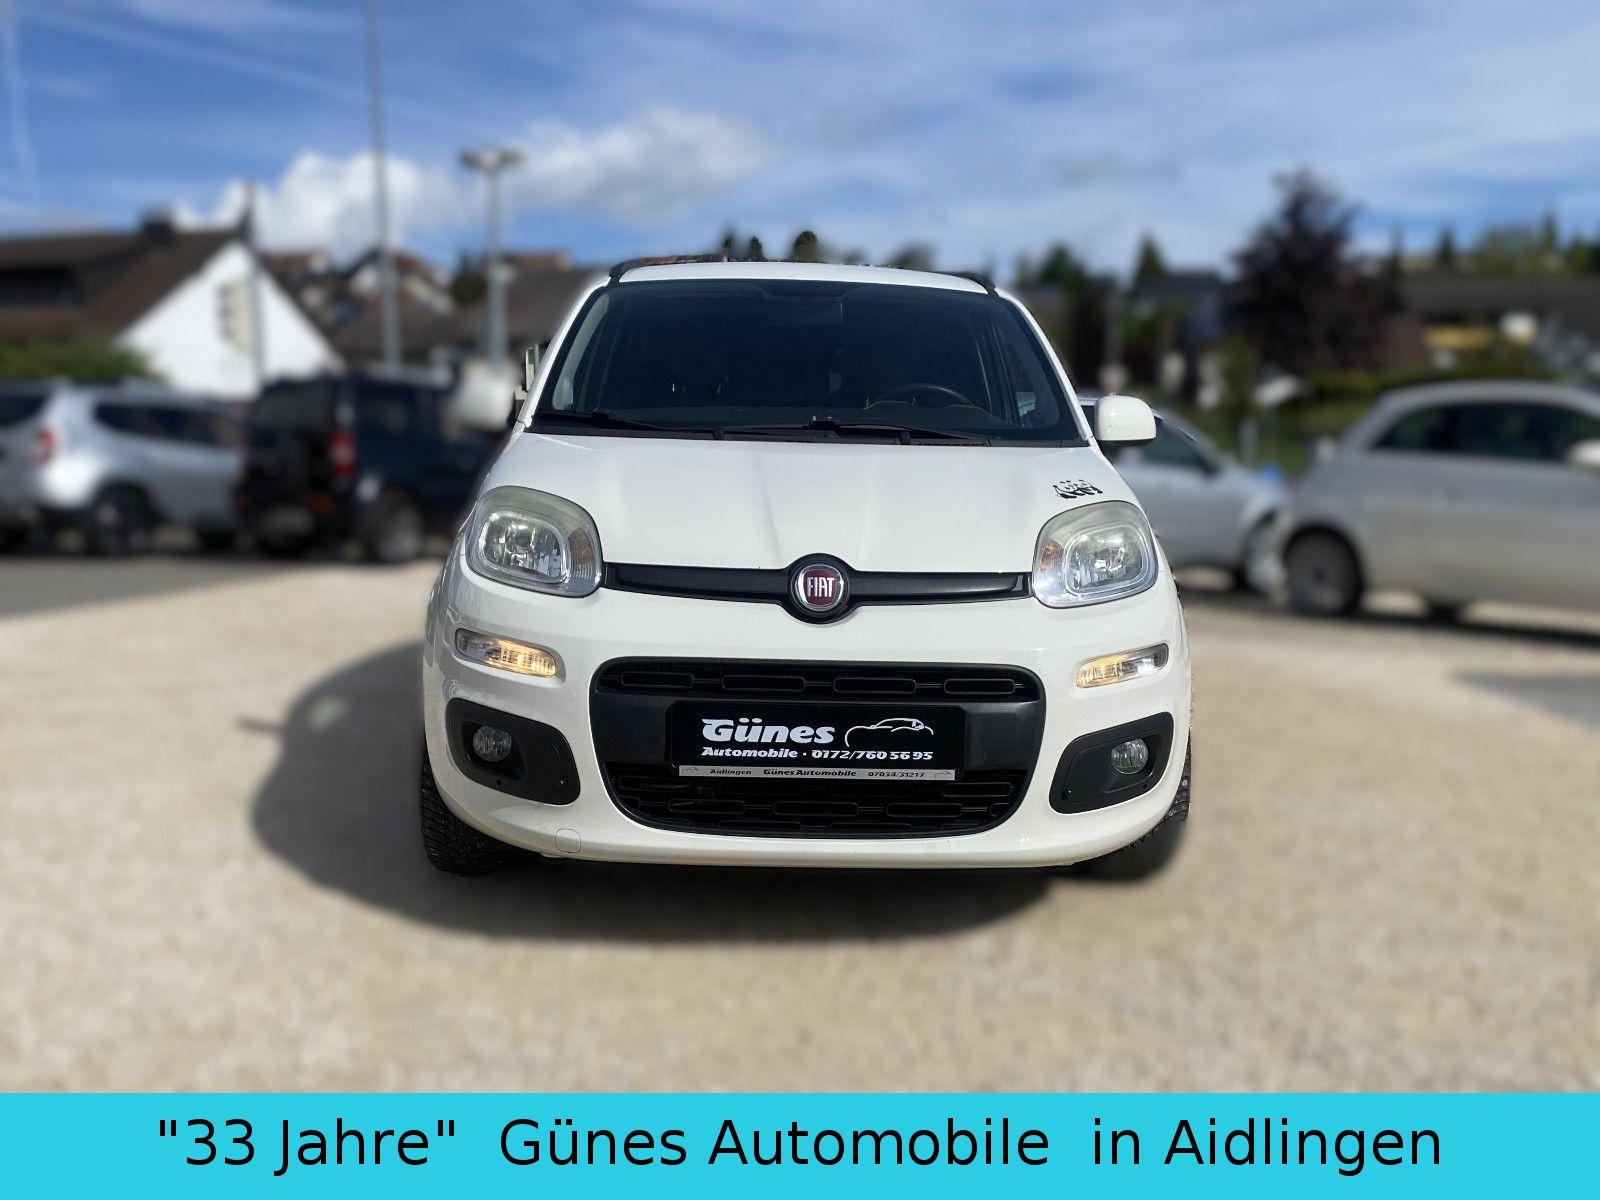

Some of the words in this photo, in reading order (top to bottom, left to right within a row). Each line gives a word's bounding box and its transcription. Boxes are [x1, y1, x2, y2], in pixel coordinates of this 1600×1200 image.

[807, 577, 835, 598] FIAT
[702, 717, 836, 744] Günes
[701, 746, 799, 759] Automobile
[709, 768, 752, 776] Aidlingen
[763, 768, 795, 776] Günes
[795, 769, 857, 777] Automobile
